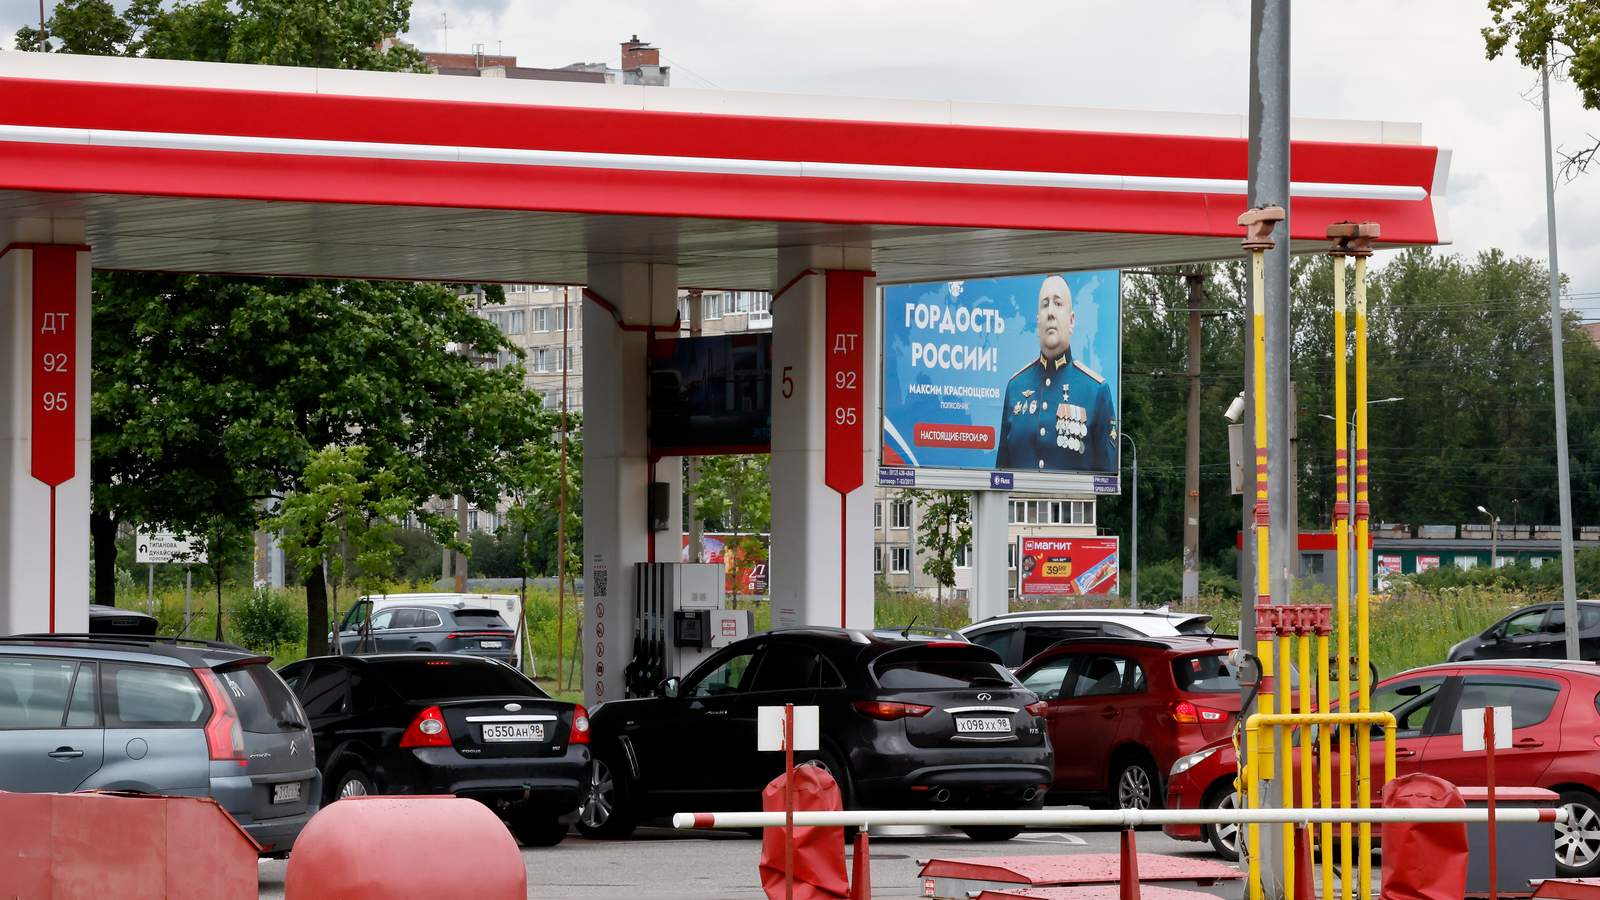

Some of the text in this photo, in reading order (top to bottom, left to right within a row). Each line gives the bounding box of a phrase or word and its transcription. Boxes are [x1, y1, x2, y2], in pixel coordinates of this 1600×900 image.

[41, 312, 70, 335] ДТ
[905, 303, 1005, 334] ГОРДОСТЬ
[834, 333, 858, 354] ДТ
[43, 352, 68, 372] 92
[911, 342, 998, 372] РОССИИ!
[782, 366, 793, 399] 5
[835, 371, 857, 389] 92
[909, 384, 1000, 398] МАКСИМ КРАСНОЩЕКОВ
[43, 392, 68, 411] 95
[835, 407, 857, 425] 95
[920, 430, 989, 442] НАСТОЯЩИЕ-ГЕРОИ.РФ
